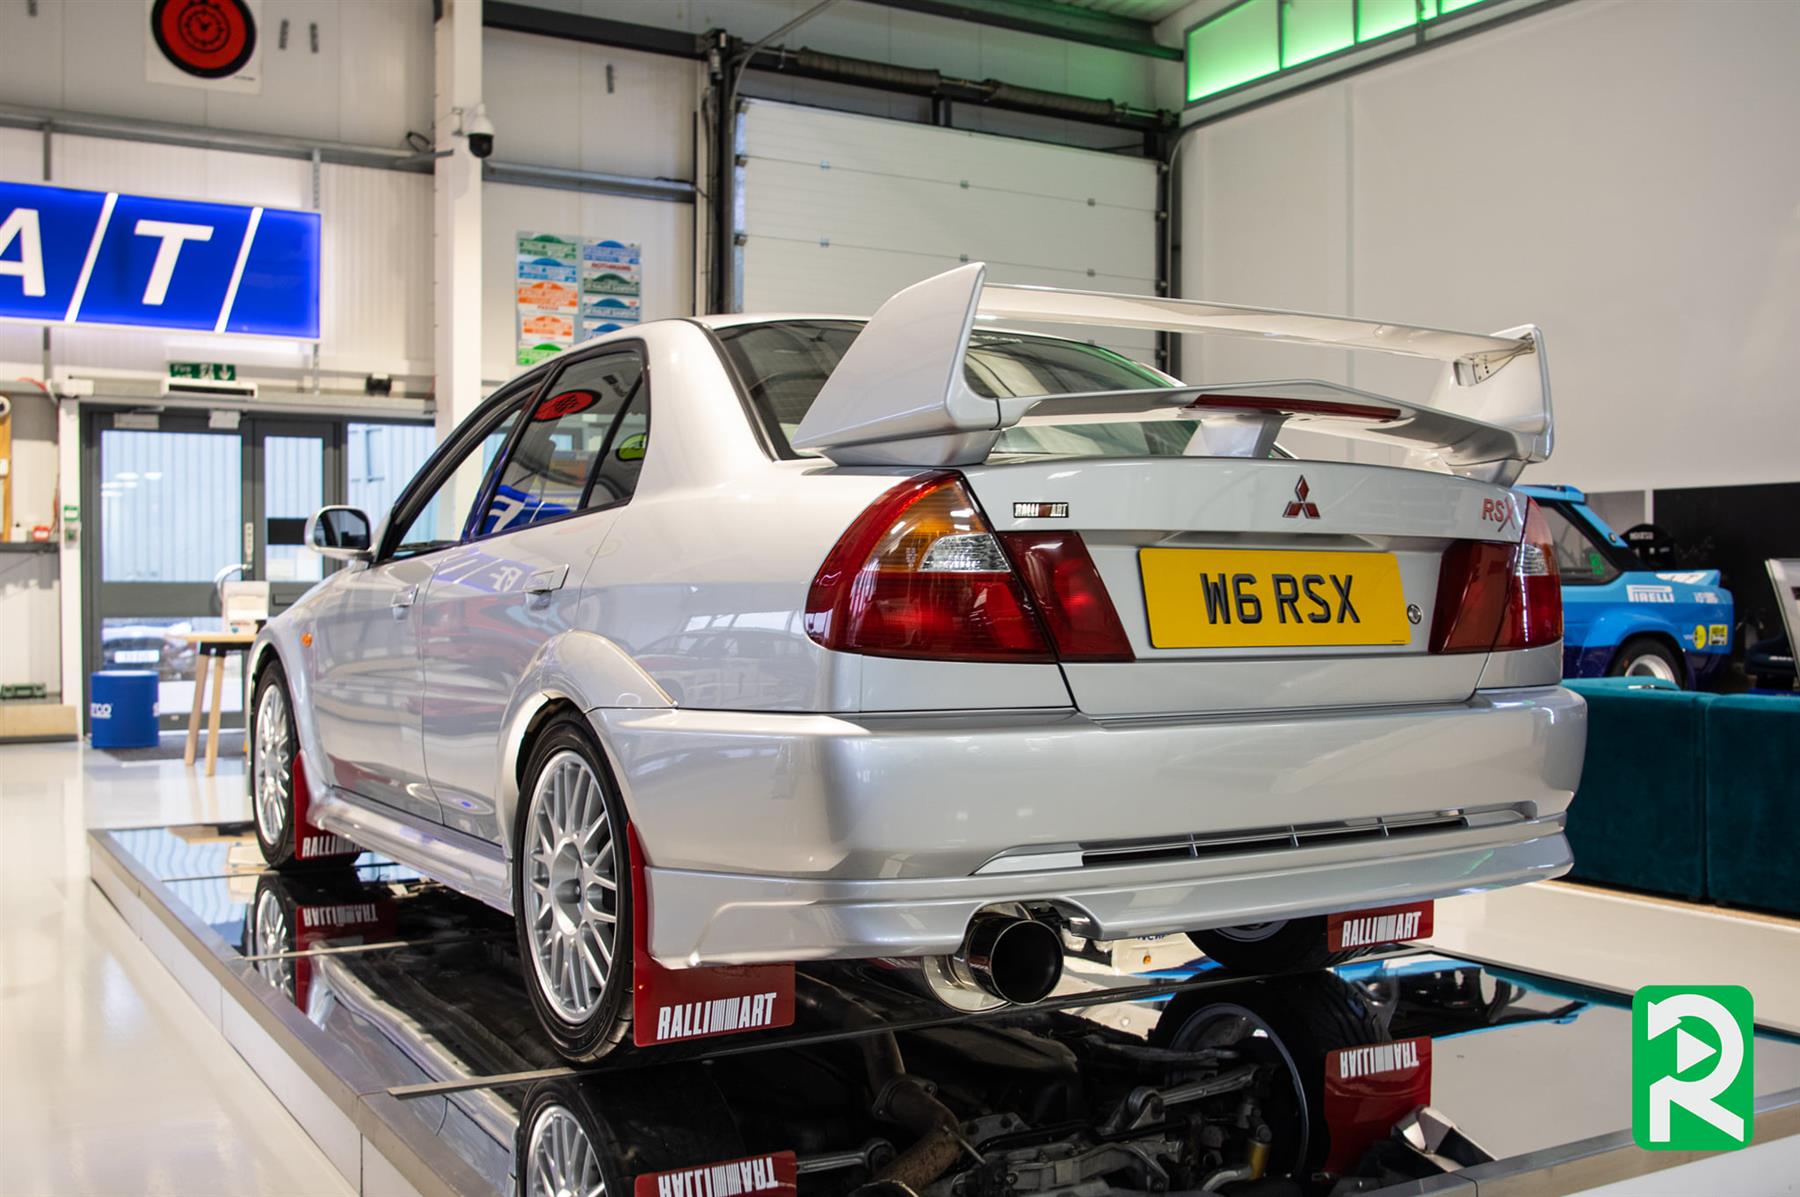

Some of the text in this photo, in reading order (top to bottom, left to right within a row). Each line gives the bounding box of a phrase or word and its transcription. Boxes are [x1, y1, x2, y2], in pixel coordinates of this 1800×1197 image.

[1482, 496, 1516, 532] RSX
[1200, 573, 1360, 625] W6 RSX
[1626, 584, 1675, 603] PIRELLI
[656, 992, 777, 1041] RALLIART
